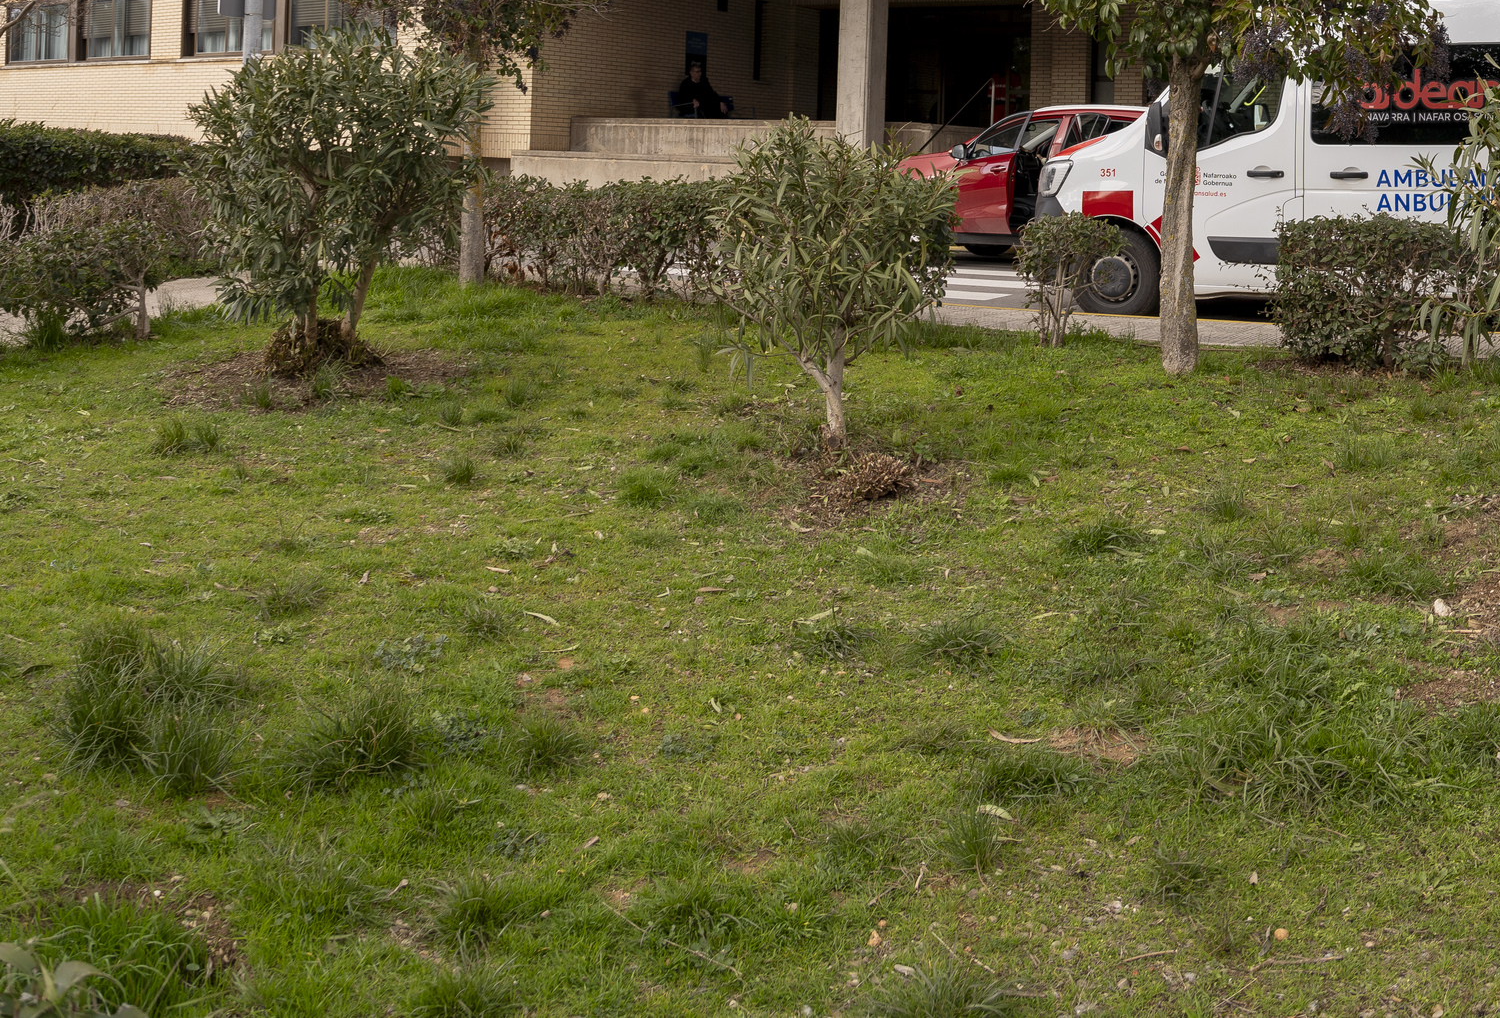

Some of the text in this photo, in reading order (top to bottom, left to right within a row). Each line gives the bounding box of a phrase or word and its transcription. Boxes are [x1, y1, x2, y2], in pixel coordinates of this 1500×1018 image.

[1418, 112, 1451, 122] NAFAR
[1100, 168, 1117, 178] 351
[1203, 172, 1237, 180] Nafarroako
